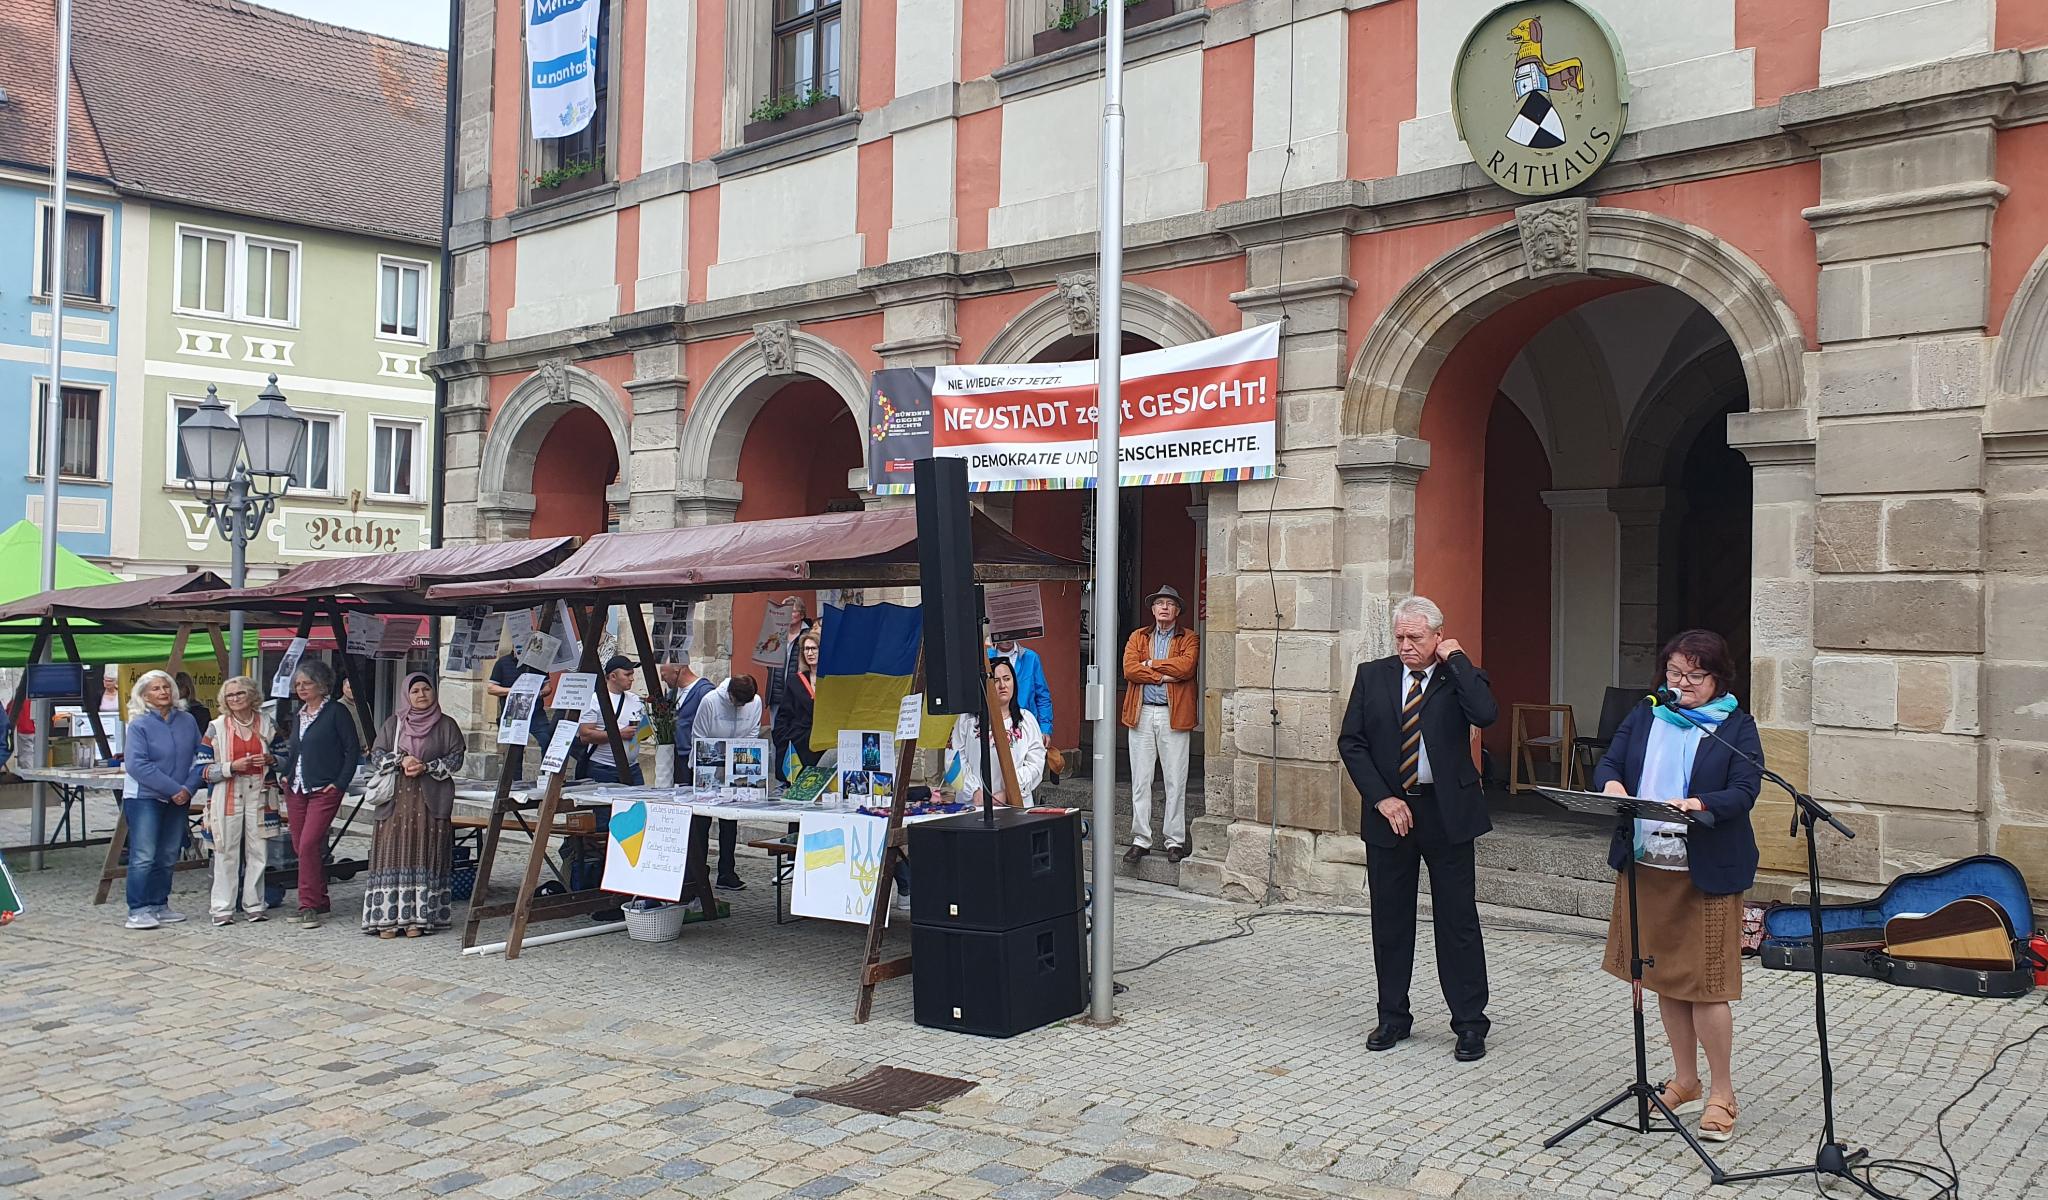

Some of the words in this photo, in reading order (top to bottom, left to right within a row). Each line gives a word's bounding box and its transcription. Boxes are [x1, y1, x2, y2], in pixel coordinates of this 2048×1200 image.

[1487, 126, 1610, 187] RATHAUS
[948, 379, 963, 390] NIE
[966, 376, 1005, 389] WIEDER
[1006, 377, 1023, 386] IST
[1025, 376, 1062, 385] JETZT.
[943, 400, 1069, 432] NEUSTADT
[1075, 399, 1134, 425] zet
[1139, 376, 1266, 418] GESICHT!
[972, 452, 1062, 468] DEMOKRATIE
[1065, 451, 1099, 465] UND
[1118, 435, 1260, 462] ENSCHENRECHTE.
[306, 517, 401, 552] Nahr
